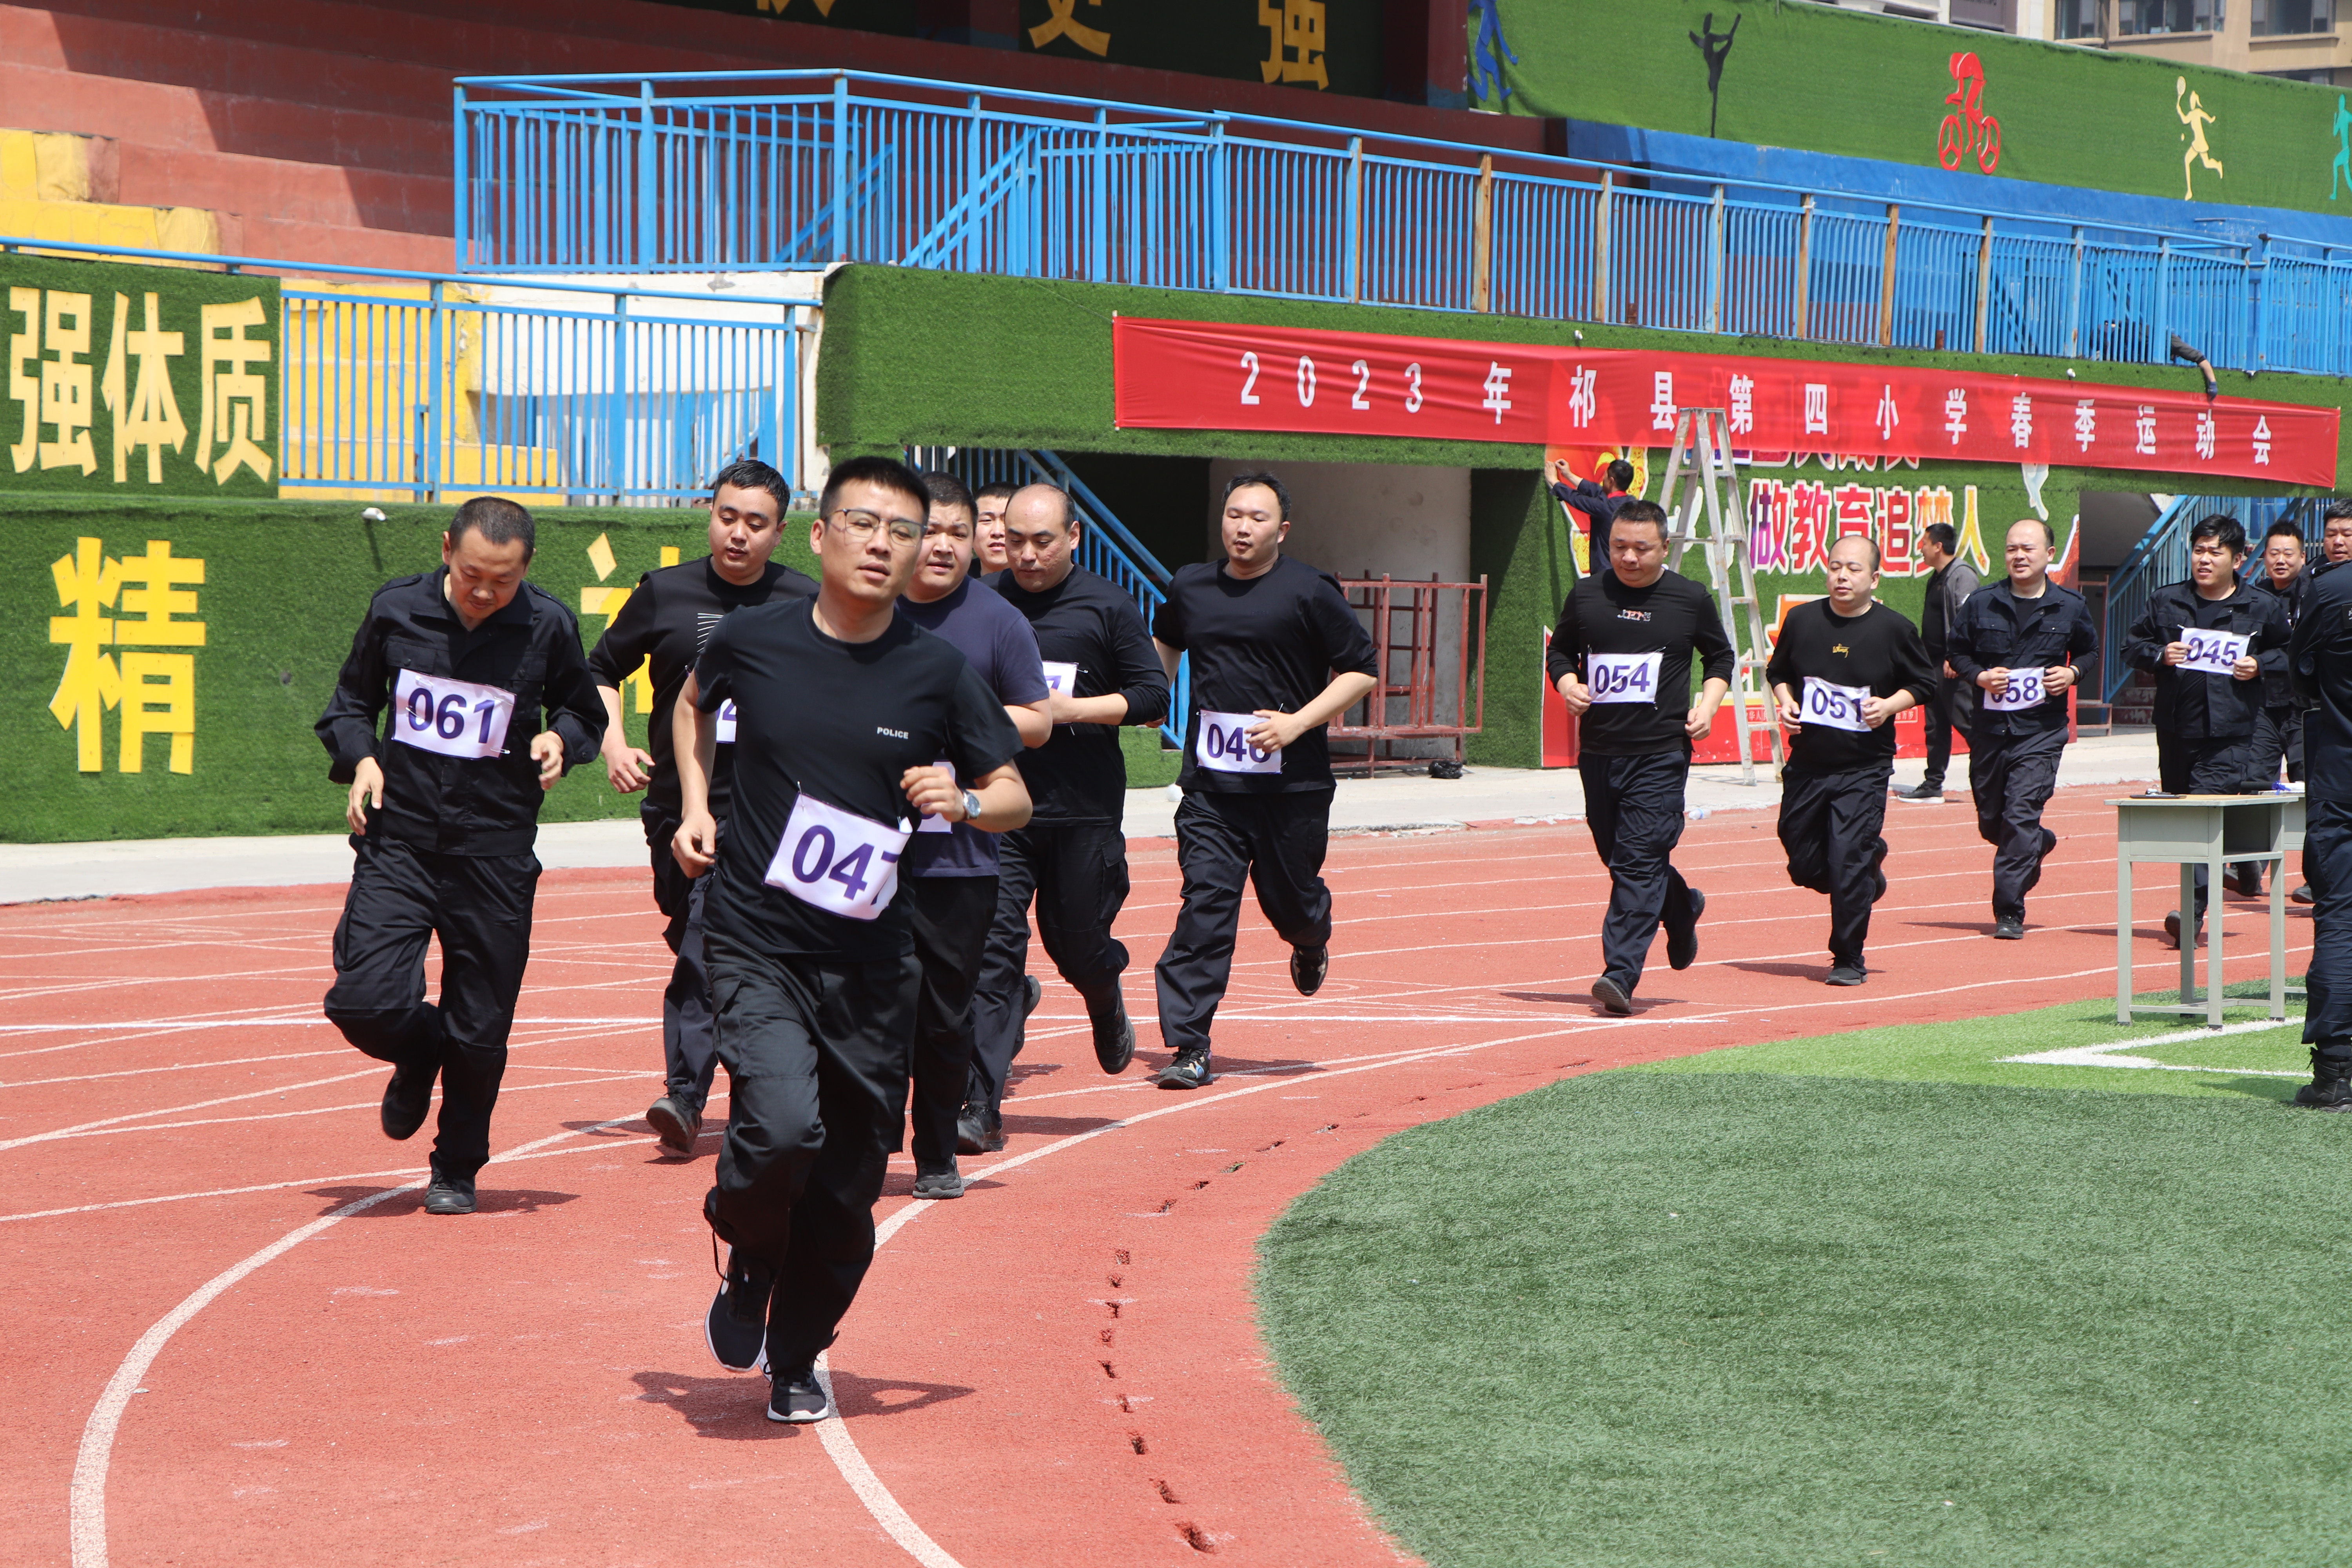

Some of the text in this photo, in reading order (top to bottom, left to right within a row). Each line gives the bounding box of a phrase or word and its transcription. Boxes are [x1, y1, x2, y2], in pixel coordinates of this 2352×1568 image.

[9, 286, 273, 486] 强体质
[1240, 351, 2273, 467] 2023年祁县第四小学春季运动会
[49, 536, 207, 775] 精
[2187, 637, 2239, 666] 045
[1595, 662, 1650, 694] 054
[408, 687, 495, 744] 061
[1812, 687, 1862, 723] 051
[877, 726, 909, 739] POLICE
